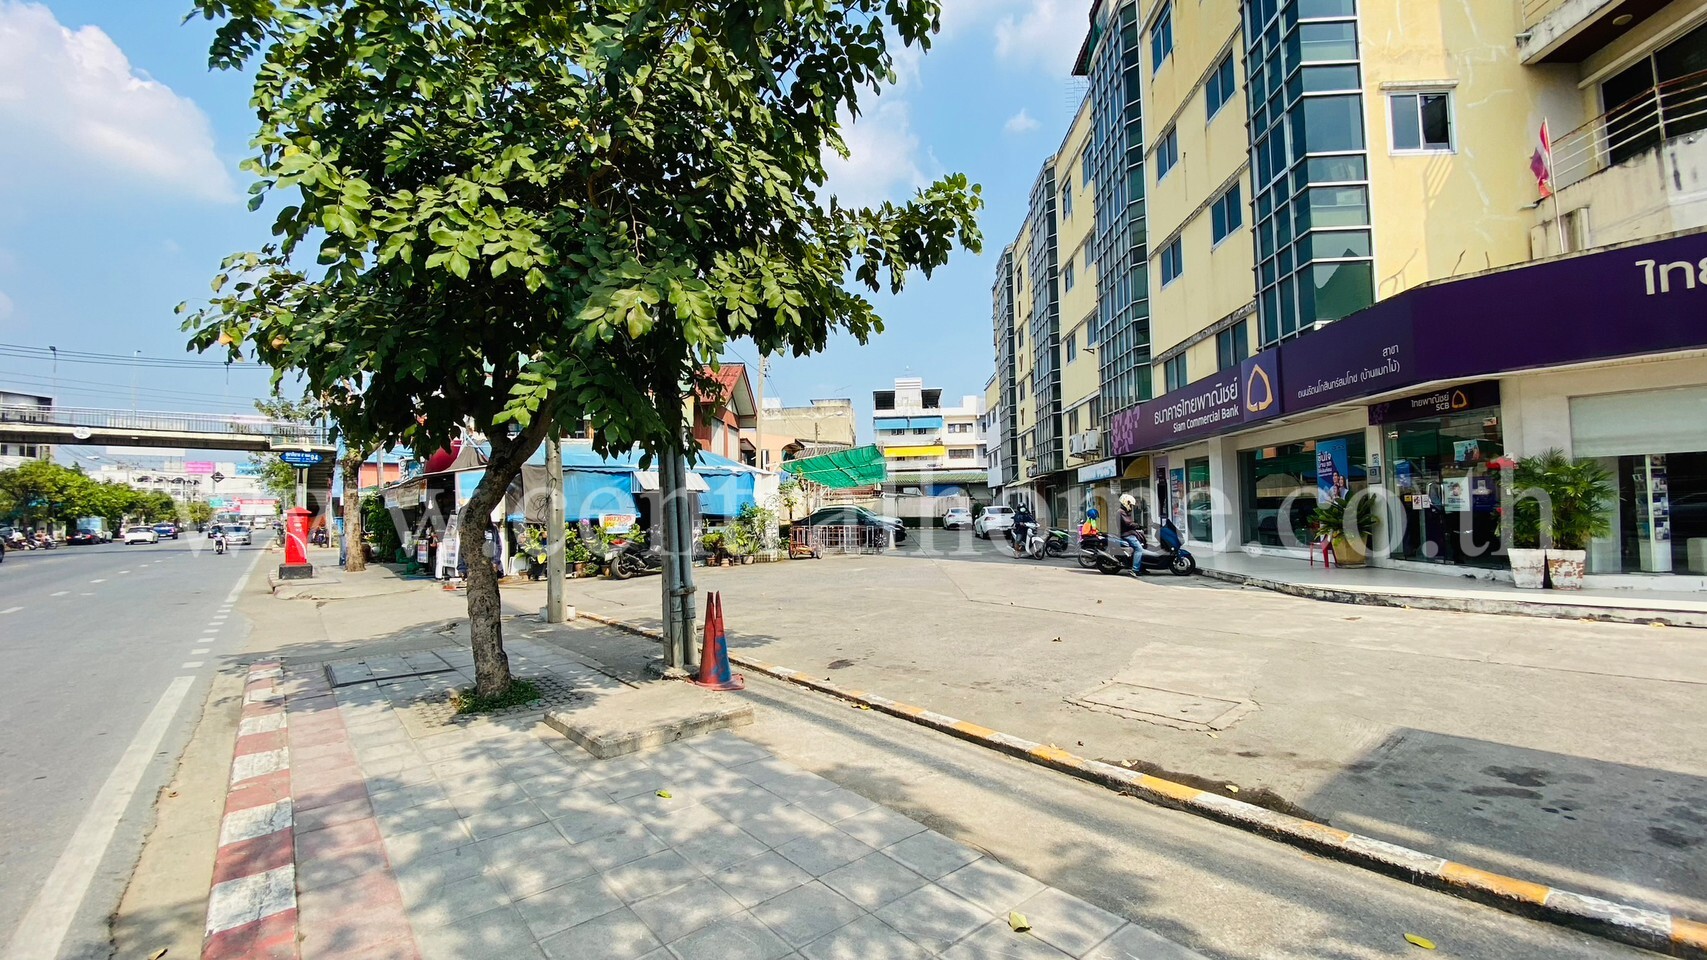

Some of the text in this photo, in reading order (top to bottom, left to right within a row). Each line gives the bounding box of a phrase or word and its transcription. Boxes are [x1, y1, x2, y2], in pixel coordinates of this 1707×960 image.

[1382, 344, 1399, 357] สาขา
[1154, 377, 1238, 424] ธนาคารไทยพาณิชย์
[1411, 391, 1449, 408] ไทยพาณิชย์
[1435, 402, 1450, 411] SCB
[1173, 404, 1239, 433] Siam Commercial Bank
